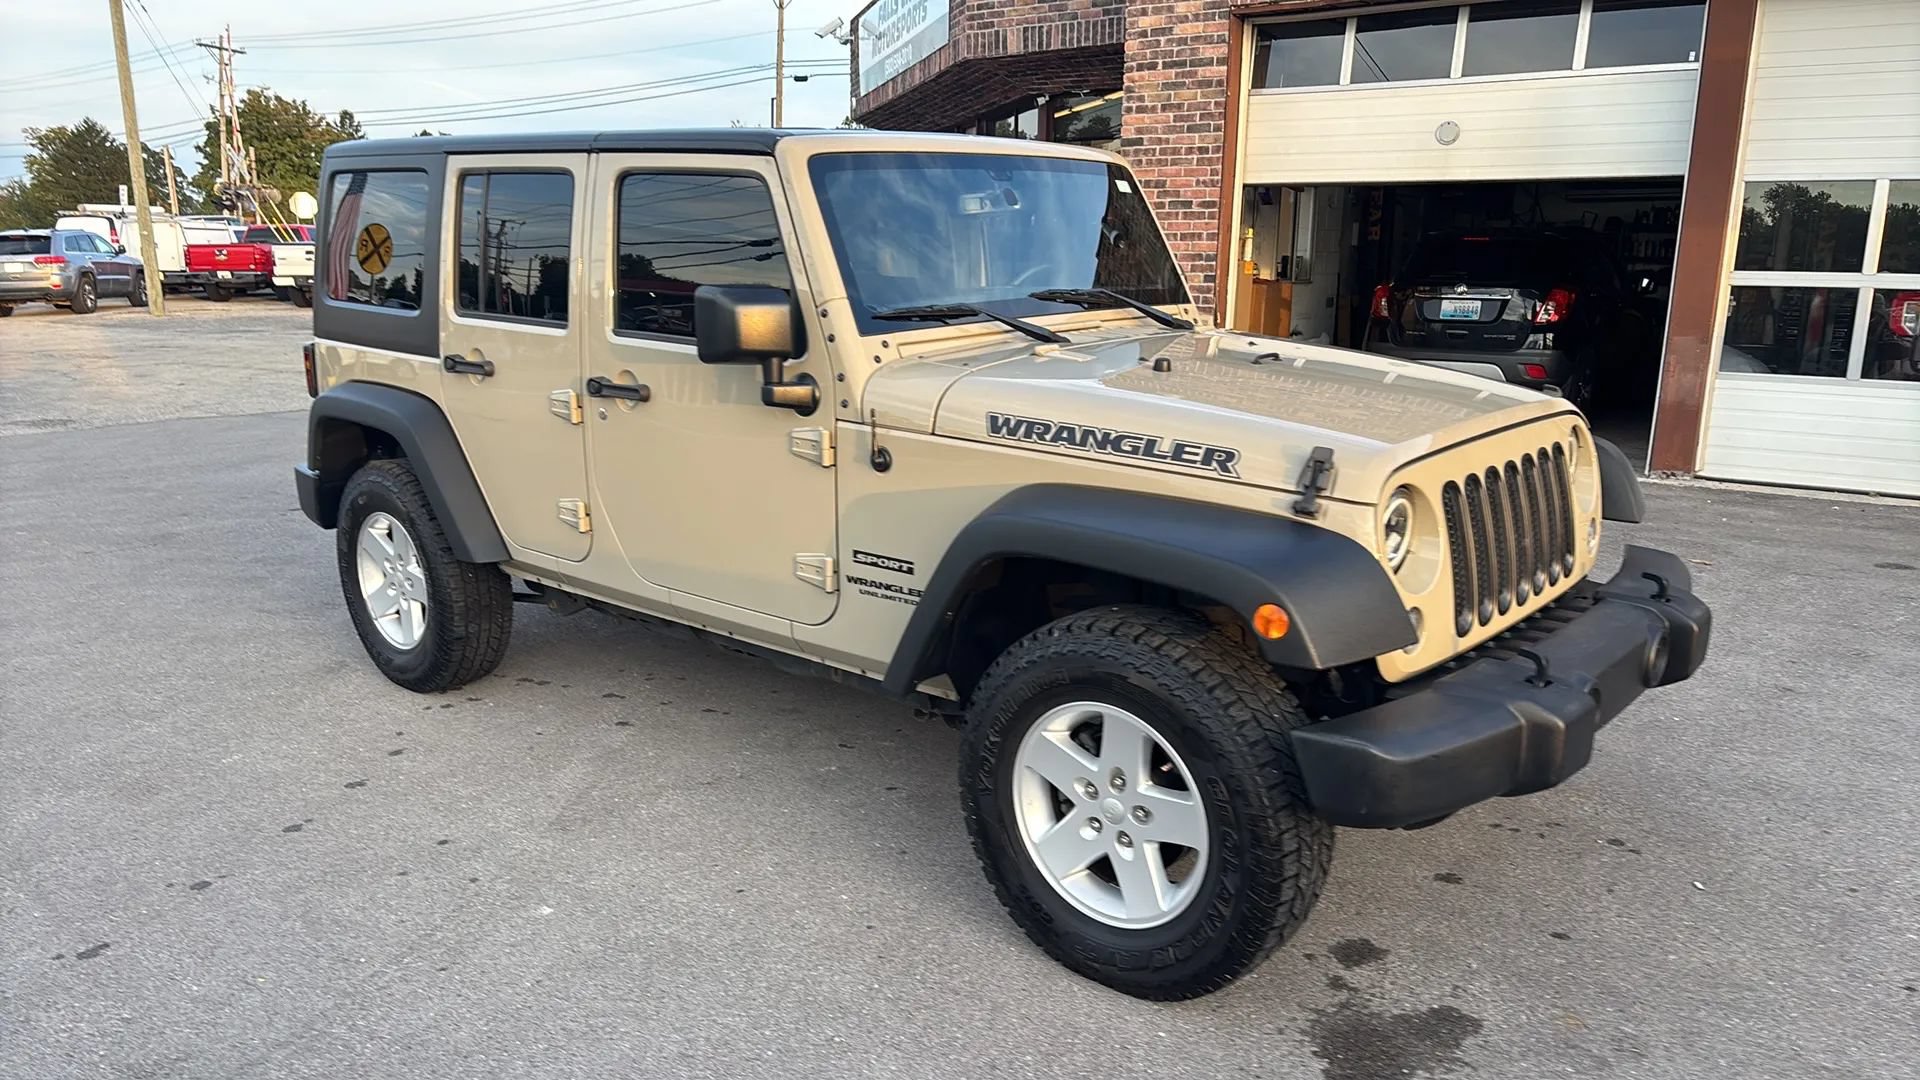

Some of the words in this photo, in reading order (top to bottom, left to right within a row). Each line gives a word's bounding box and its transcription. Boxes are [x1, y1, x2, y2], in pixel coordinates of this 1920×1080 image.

[872, 0, 928, 60] MOTORSPORTS
[985, 411, 1241, 479] WRANGLER
[855, 553, 913, 572] SPORT
[859, 589, 919, 606] UNLIMITED
